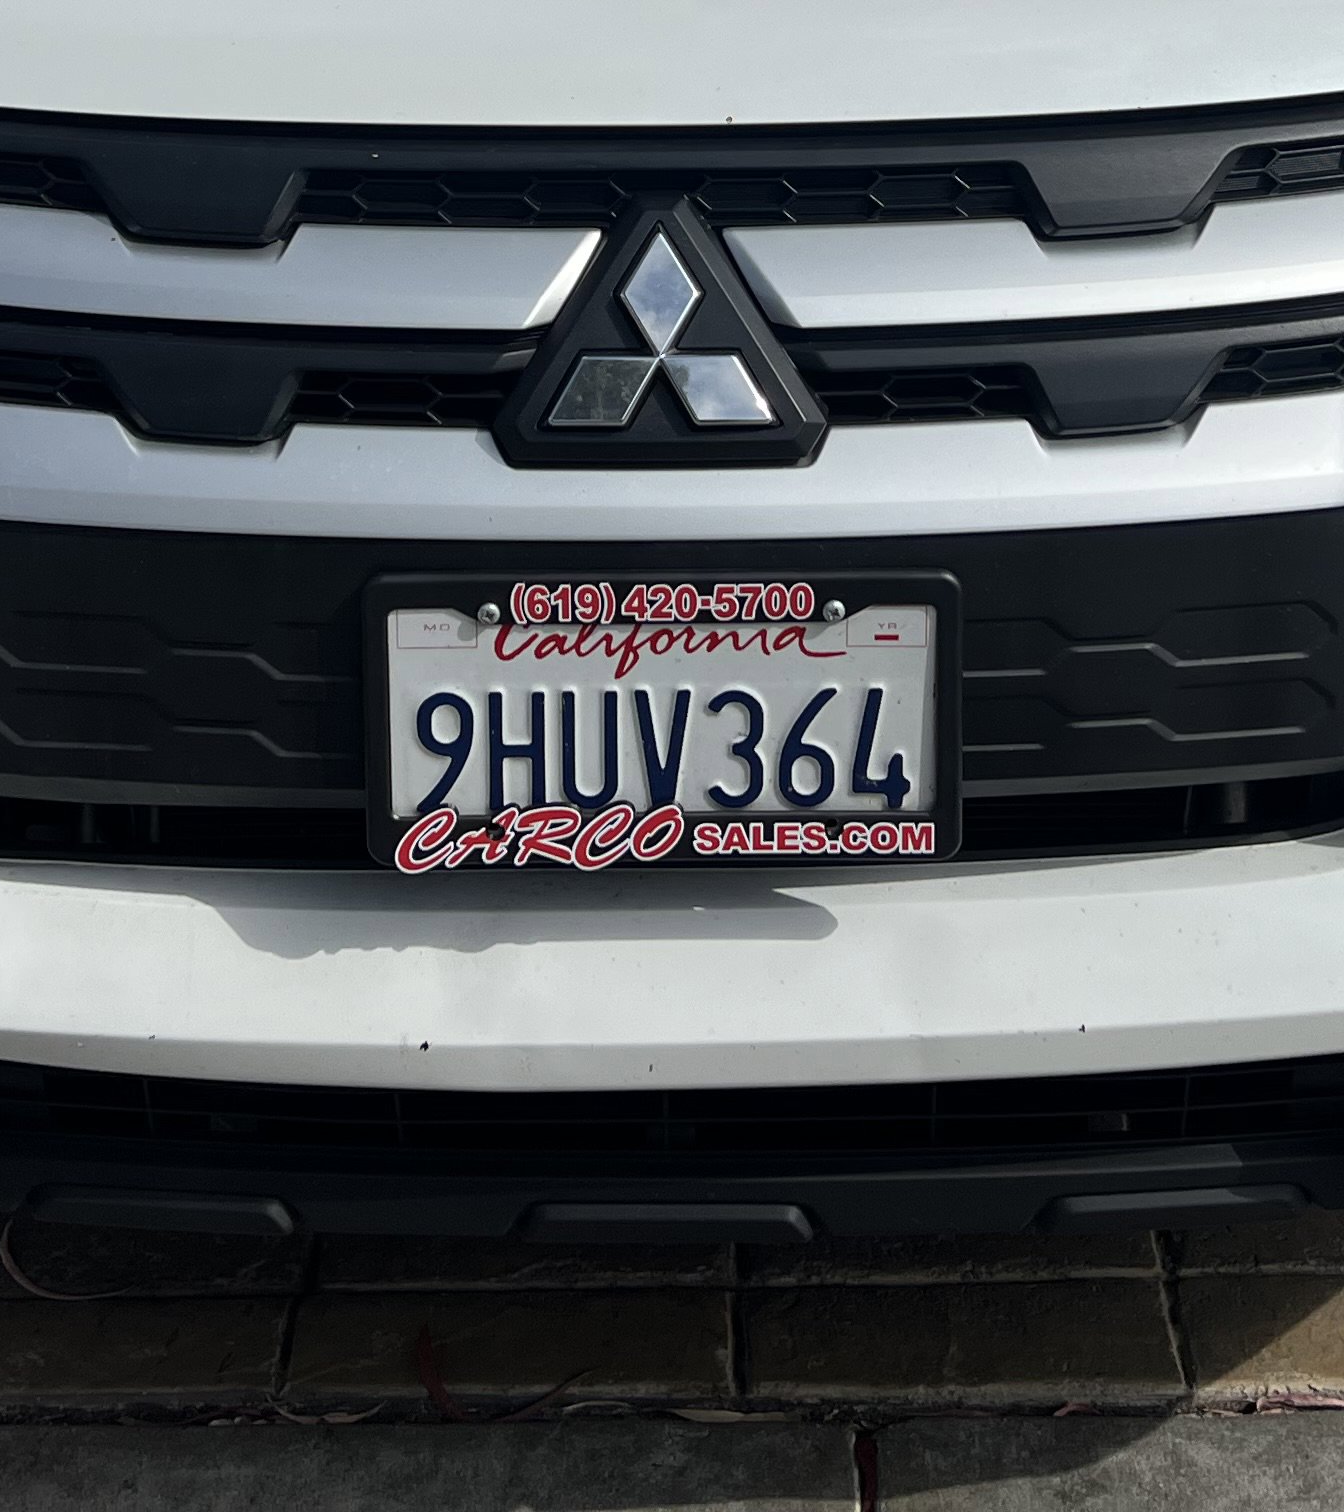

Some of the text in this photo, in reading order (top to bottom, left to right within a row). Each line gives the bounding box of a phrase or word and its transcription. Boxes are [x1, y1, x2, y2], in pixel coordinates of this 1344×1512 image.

[510, 581, 815, 625] (619) 420-5700
[493, 622, 848, 680] California
[415, 687, 911, 810] 9HUV364
[394, 802, 935, 875] CARCO SALES.COM
